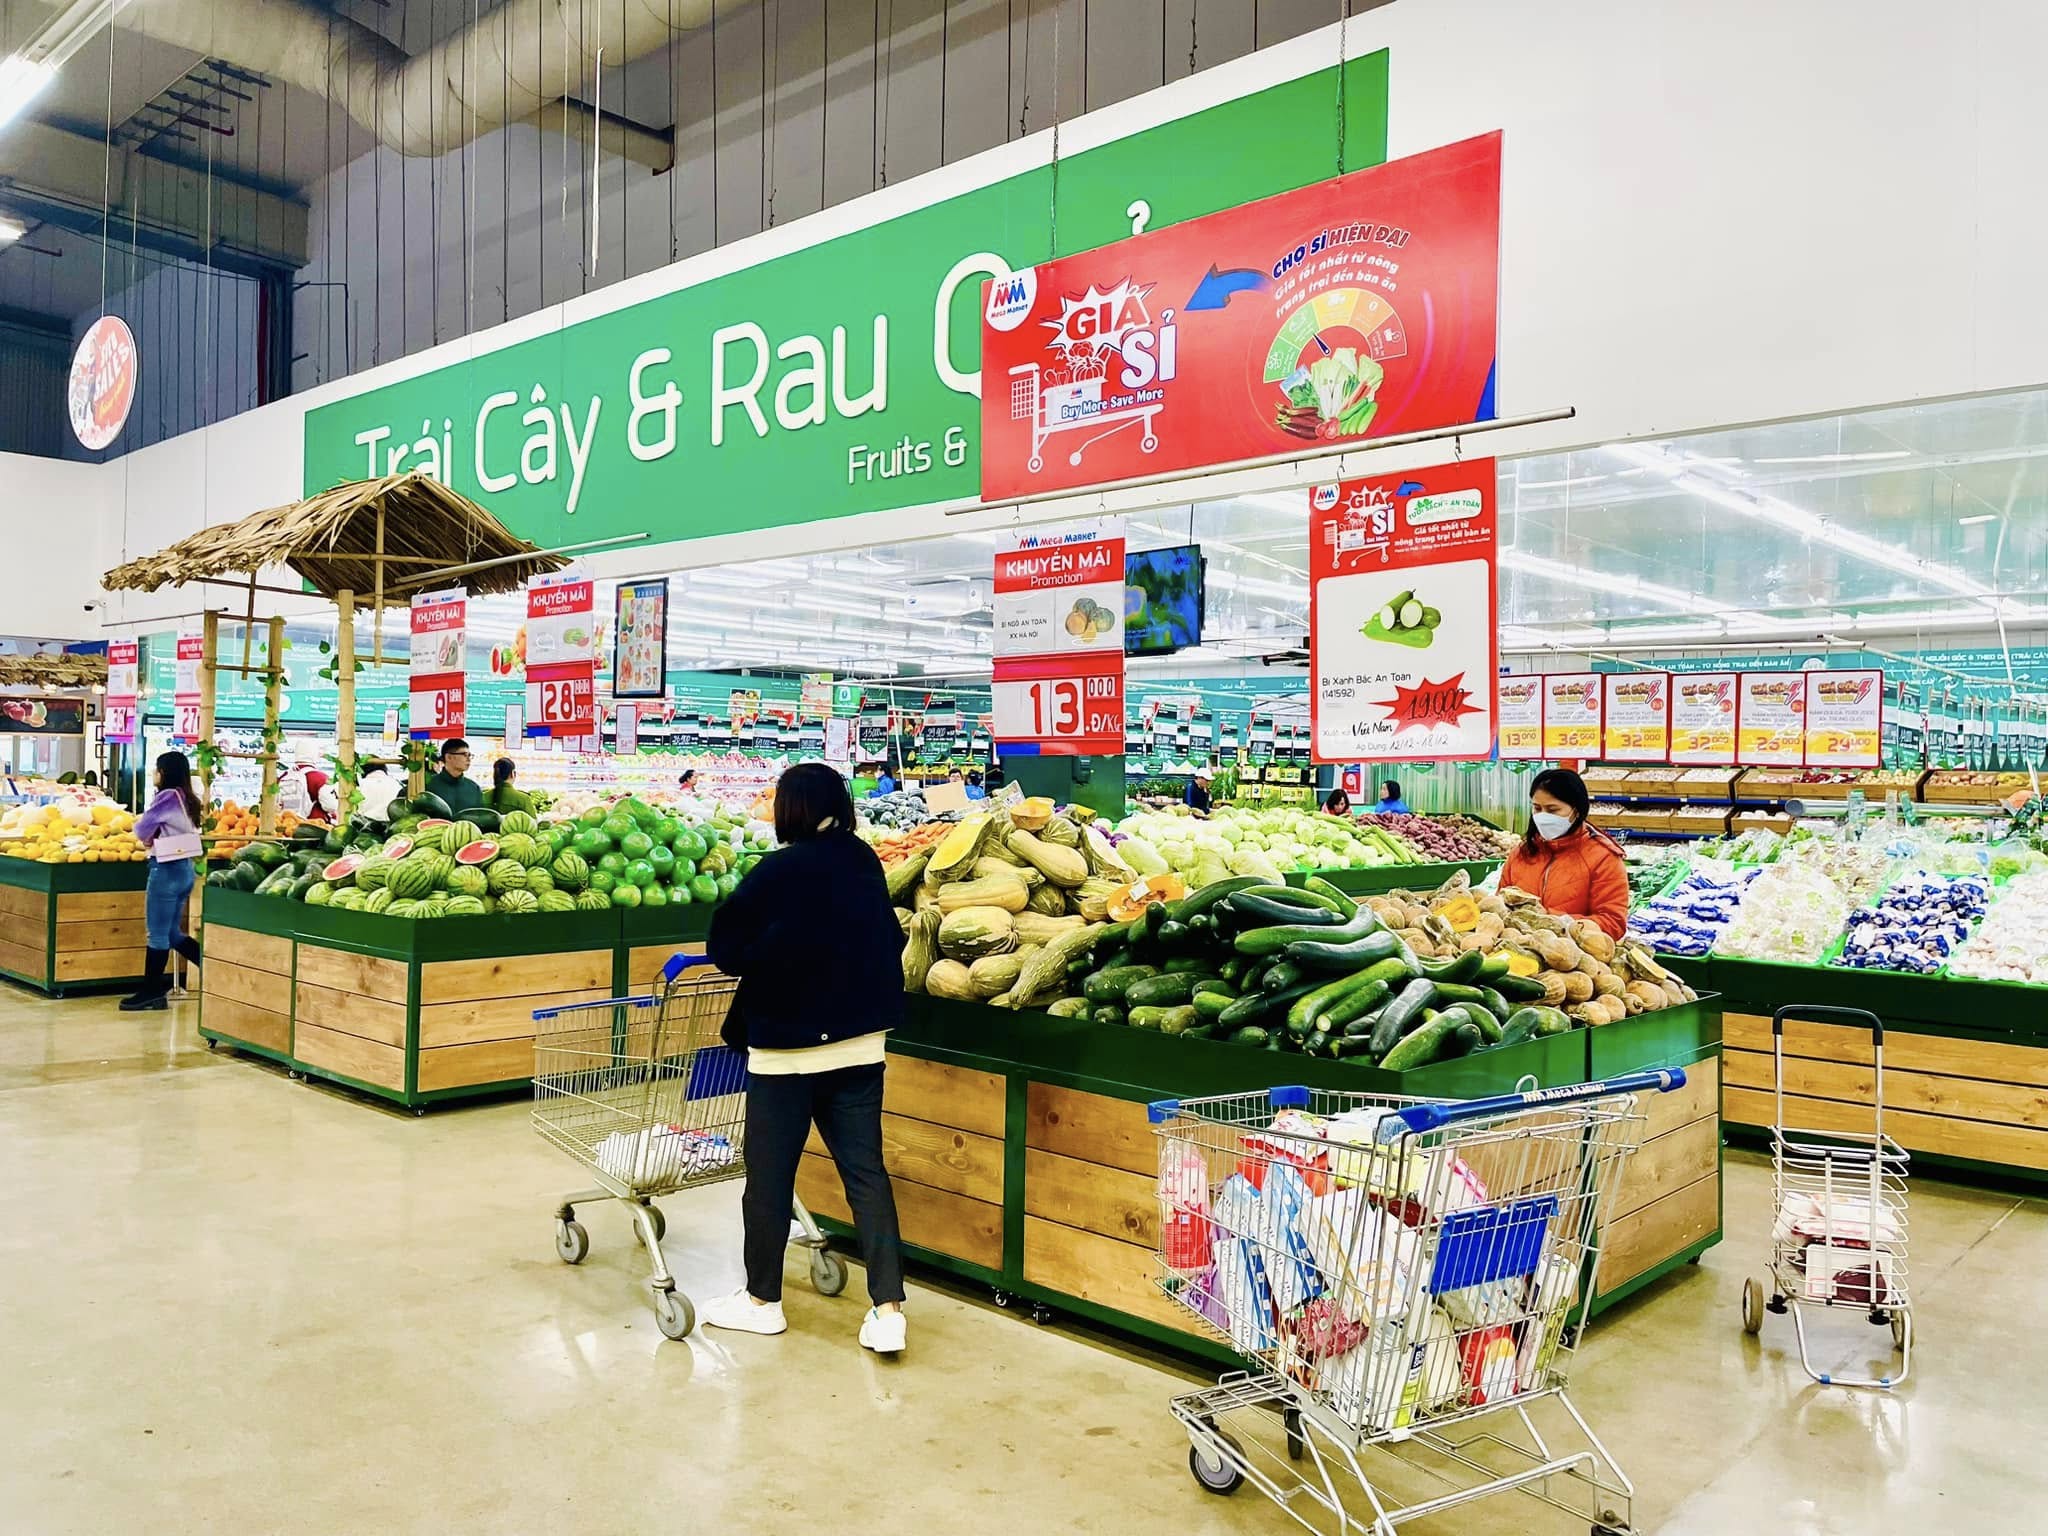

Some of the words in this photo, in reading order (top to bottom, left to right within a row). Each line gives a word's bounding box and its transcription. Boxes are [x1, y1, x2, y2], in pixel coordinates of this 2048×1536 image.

[1272, 243, 1307, 279] CHỢ
[1328, 222, 1373, 247] HIỆN
[1374, 225, 1411, 248] ĐẠI
[1274, 276, 1297, 300] Giá
[1299, 262, 1317, 283] tốt
[1318, 250, 1349, 273] nhất
[1366, 253, 1400, 275] nông
[1276, 288, 1306, 319] trang
[1308, 275, 1330, 293] trại
[1331, 266, 1354, 284] đến
[1380, 277, 1398, 293] ăn
[1120, 308, 1177, 389] SỈ
[474, 383, 601, 514] Cây
[626, 347, 683, 462] &
[710, 314, 889, 447] Rau
[1061, 404, 1081, 420] Buy
[1081, 400, 1108, 414] More
[1110, 395, 1134, 408] Save
[1135, 388, 1165, 404] More
[847, 433, 932, 485] Fruits
[943, 427, 967, 467] &
[1414, 535, 1435, 544] trang
[1005, 546, 1074, 578] KHUYẾN
[1078, 545, 1112, 569] MÃI
[1030, 572, 1084, 588] Promotion
[533, 590, 568, 608] KHUYẾN
[569, 587, 587, 601] MÃI
[545, 604, 573, 615] Promotion
[416, 606, 445, 625] KHUYẾN
[1087, 677, 1115, 697] 000
[1332, 676, 1354, 686] Xanh
[1375, 673, 1388, 682] An
[435, 691, 446, 726] 9
[544, 682, 573, 721] 28
[1372, 721, 1393, 734] Nam
